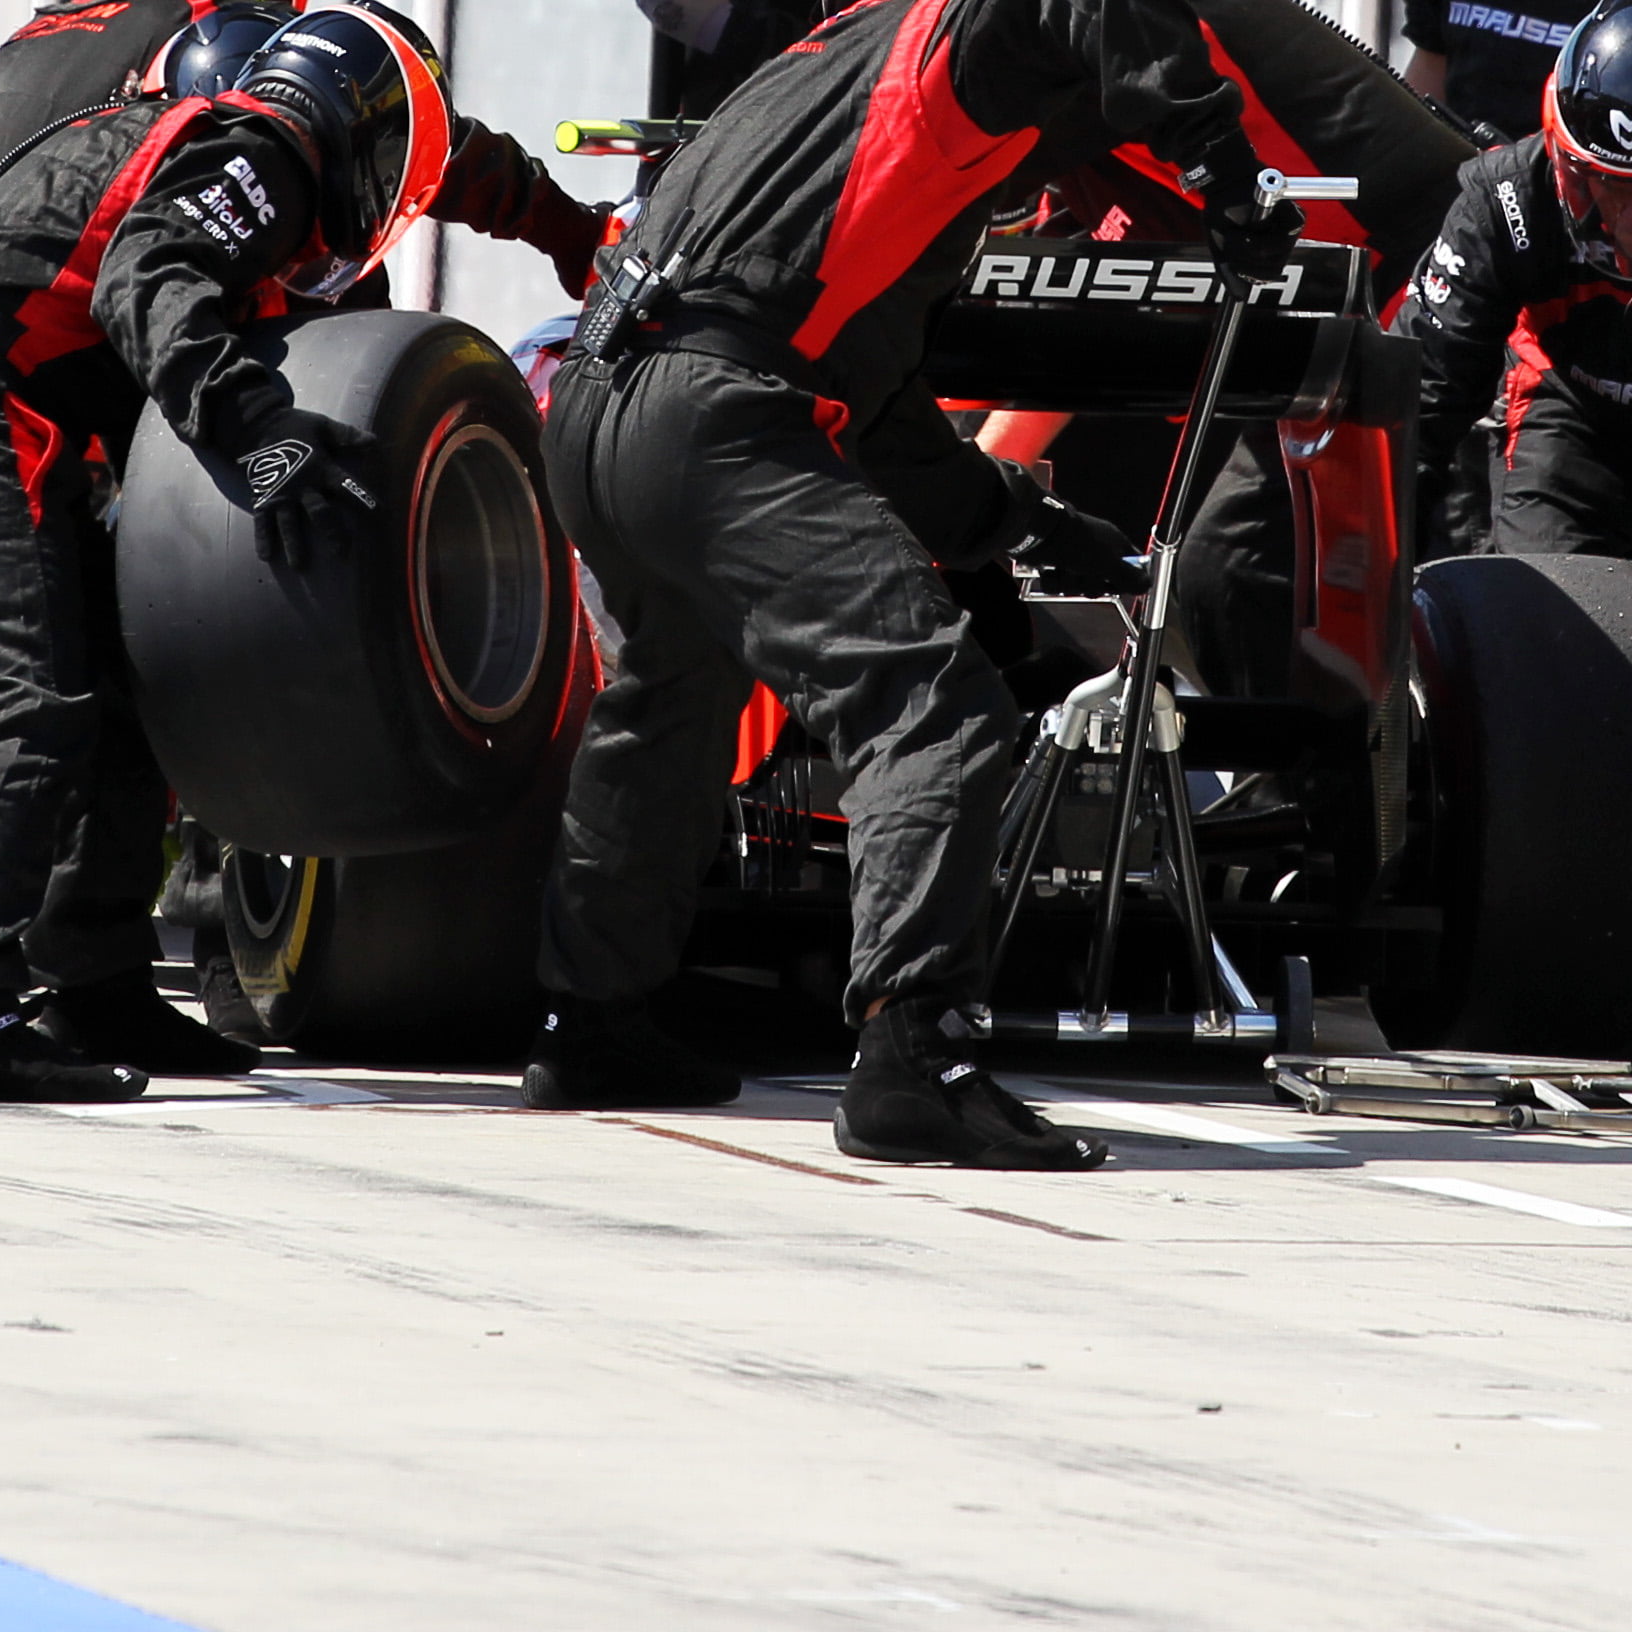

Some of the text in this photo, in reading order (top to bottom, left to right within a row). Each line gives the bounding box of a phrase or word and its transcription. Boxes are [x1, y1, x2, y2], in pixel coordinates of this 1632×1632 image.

[296, 33, 348, 58] ANTHONY
[237, 171, 276, 226] LDC
[1495, 179, 1531, 253] sparco
[201, 219, 229, 242] ERP
[970, 254, 1305, 306] RUSSA
